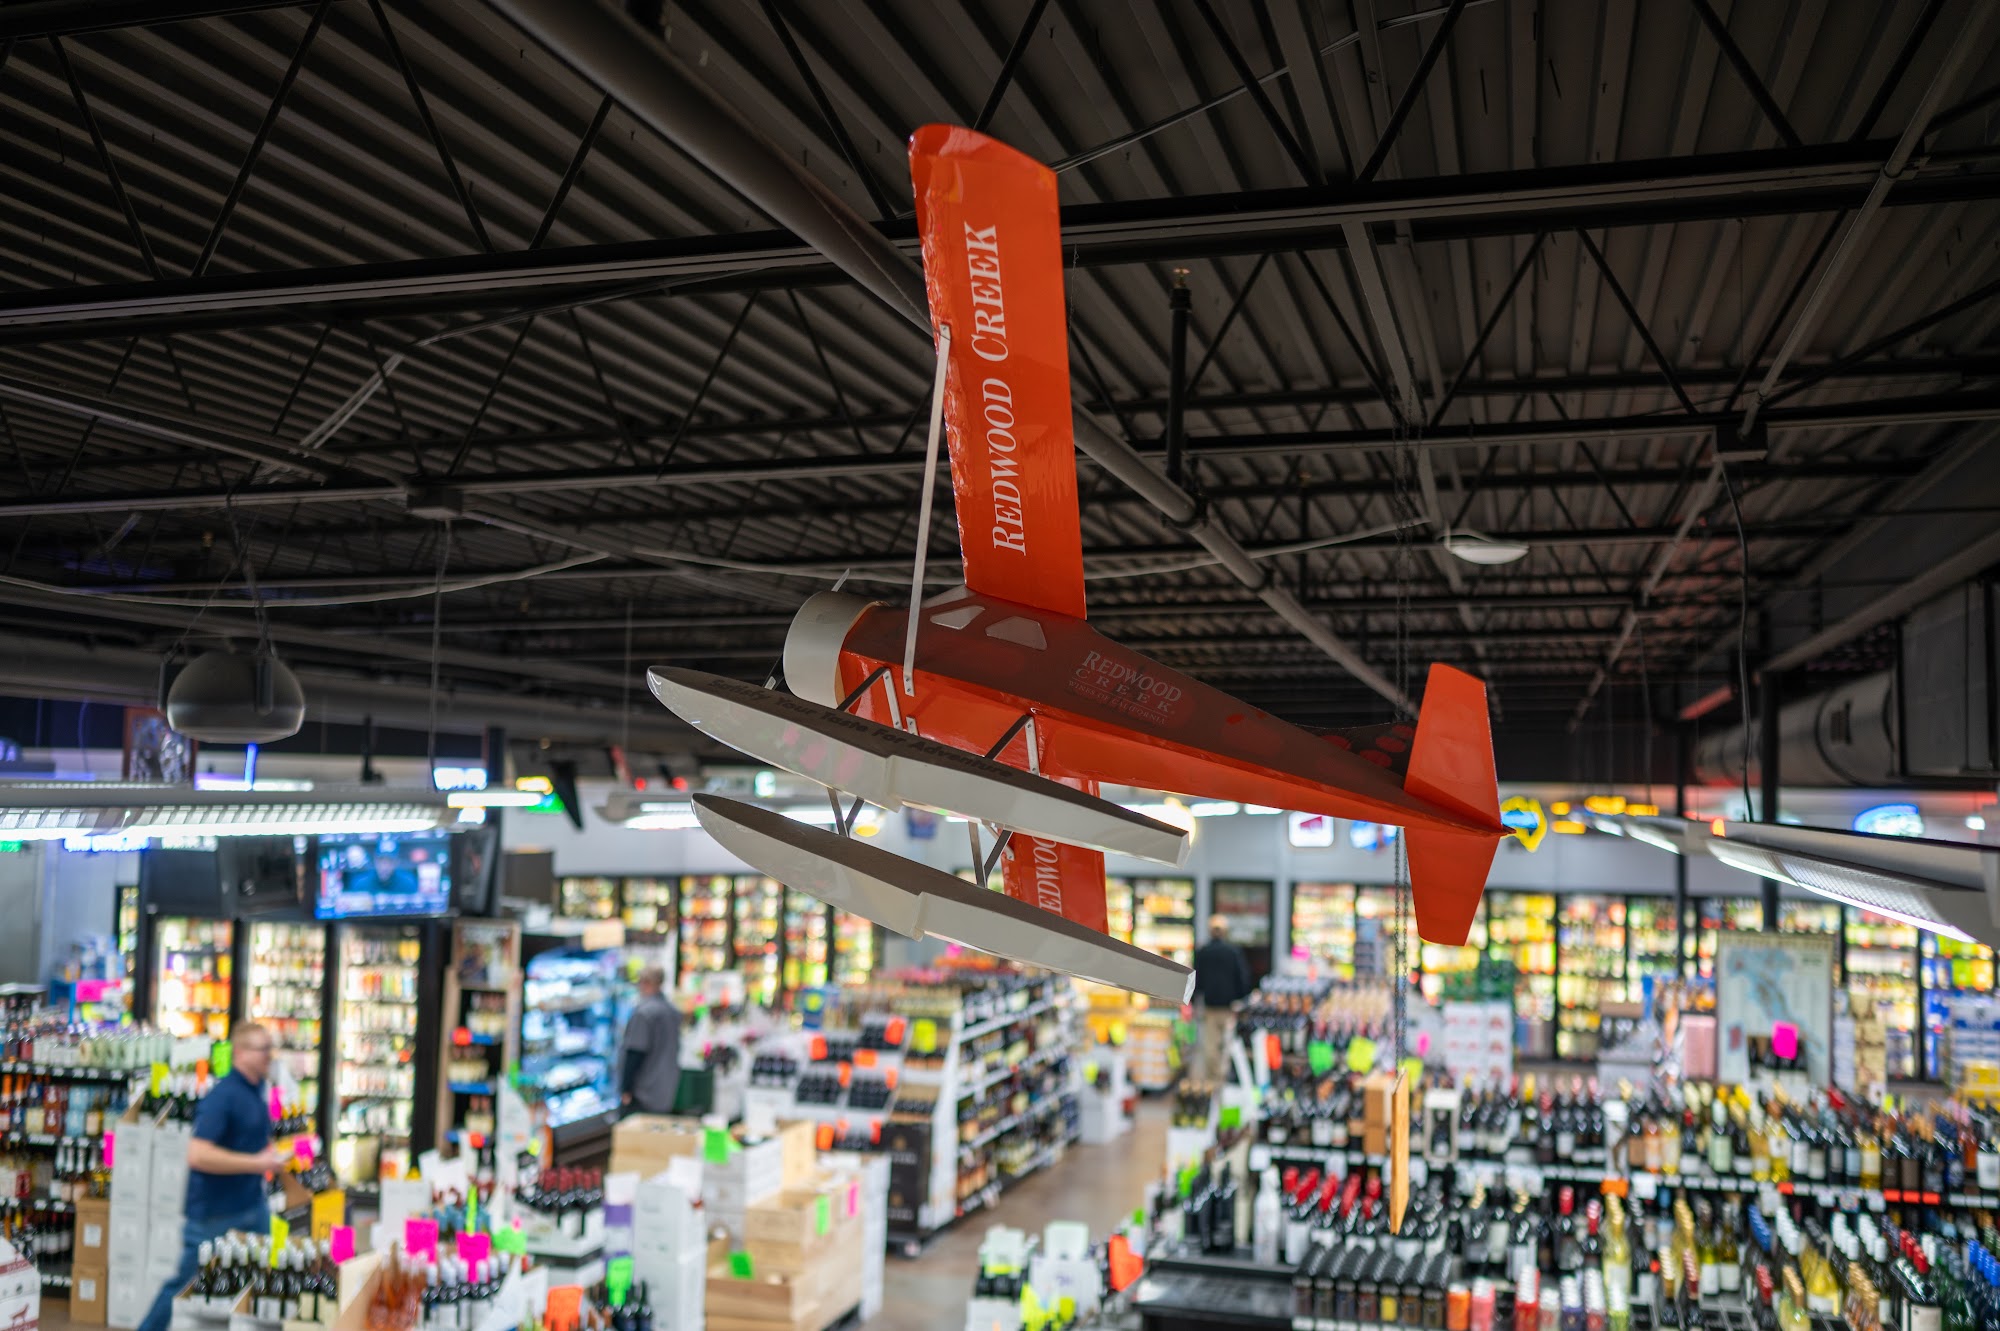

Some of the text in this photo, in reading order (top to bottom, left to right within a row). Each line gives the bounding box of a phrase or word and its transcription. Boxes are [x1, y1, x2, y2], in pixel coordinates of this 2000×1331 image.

[963, 221, 1026, 557] REDWOOD CREEK
[1075, 668, 1172, 713] CREEK
[1081, 650, 1182, 702] REDWOOD
[1068, 680, 1166, 725] WINES OF CALIFORNIA
[775, 697, 818, 714] Your
[819, 711, 869, 732] Taste
[871, 727, 907, 744] For
[909, 740, 1013, 777] Adventure
